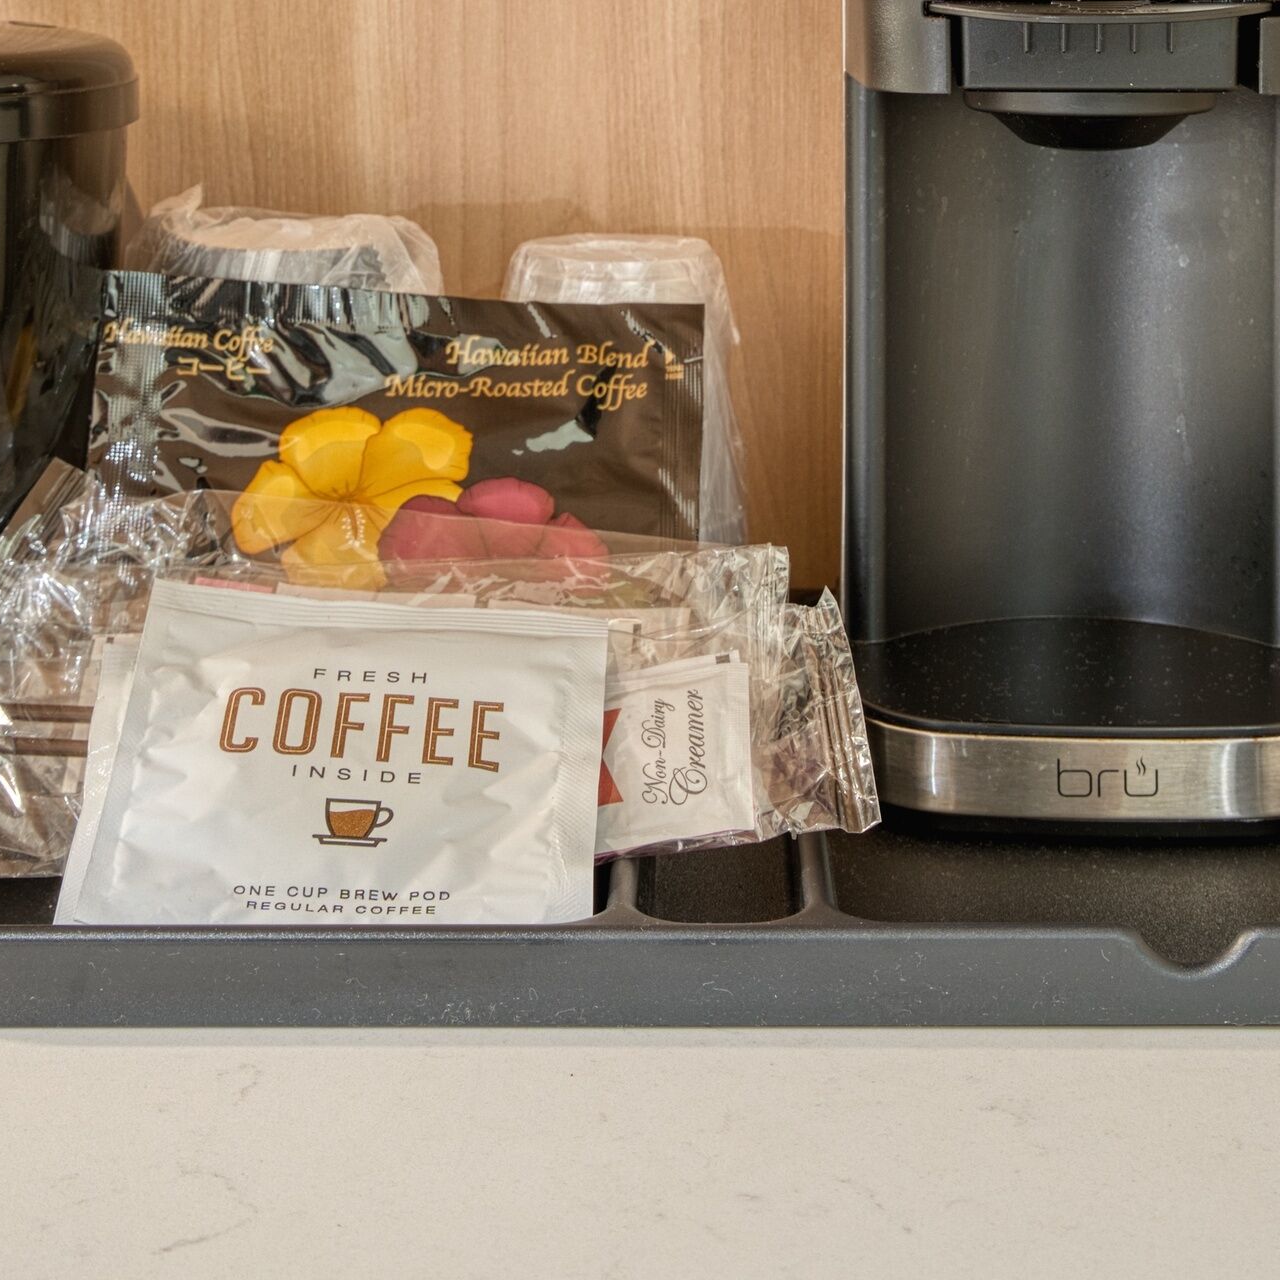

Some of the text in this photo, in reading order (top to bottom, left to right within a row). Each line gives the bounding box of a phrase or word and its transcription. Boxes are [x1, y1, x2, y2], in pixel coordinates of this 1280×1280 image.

[103, 316, 274, 362] Hawaiian Coffee
[445, 334, 656, 369] Hawaiian Blend
[176, 356, 272, 381] コーヒー
[383, 369, 649, 411] Micro-Roasted Coffee
[312, 667, 429, 685] FRESH
[219, 686, 506, 773] COFFEE
[640, 697, 676, 806] Non-Dairy
[668, 688, 708, 807] Creamer
[290, 764, 423, 785] INSIDE
[232, 884, 451, 902] ONE CUP BREW POD
[245, 900, 437, 916] REGULAR COFFEE
